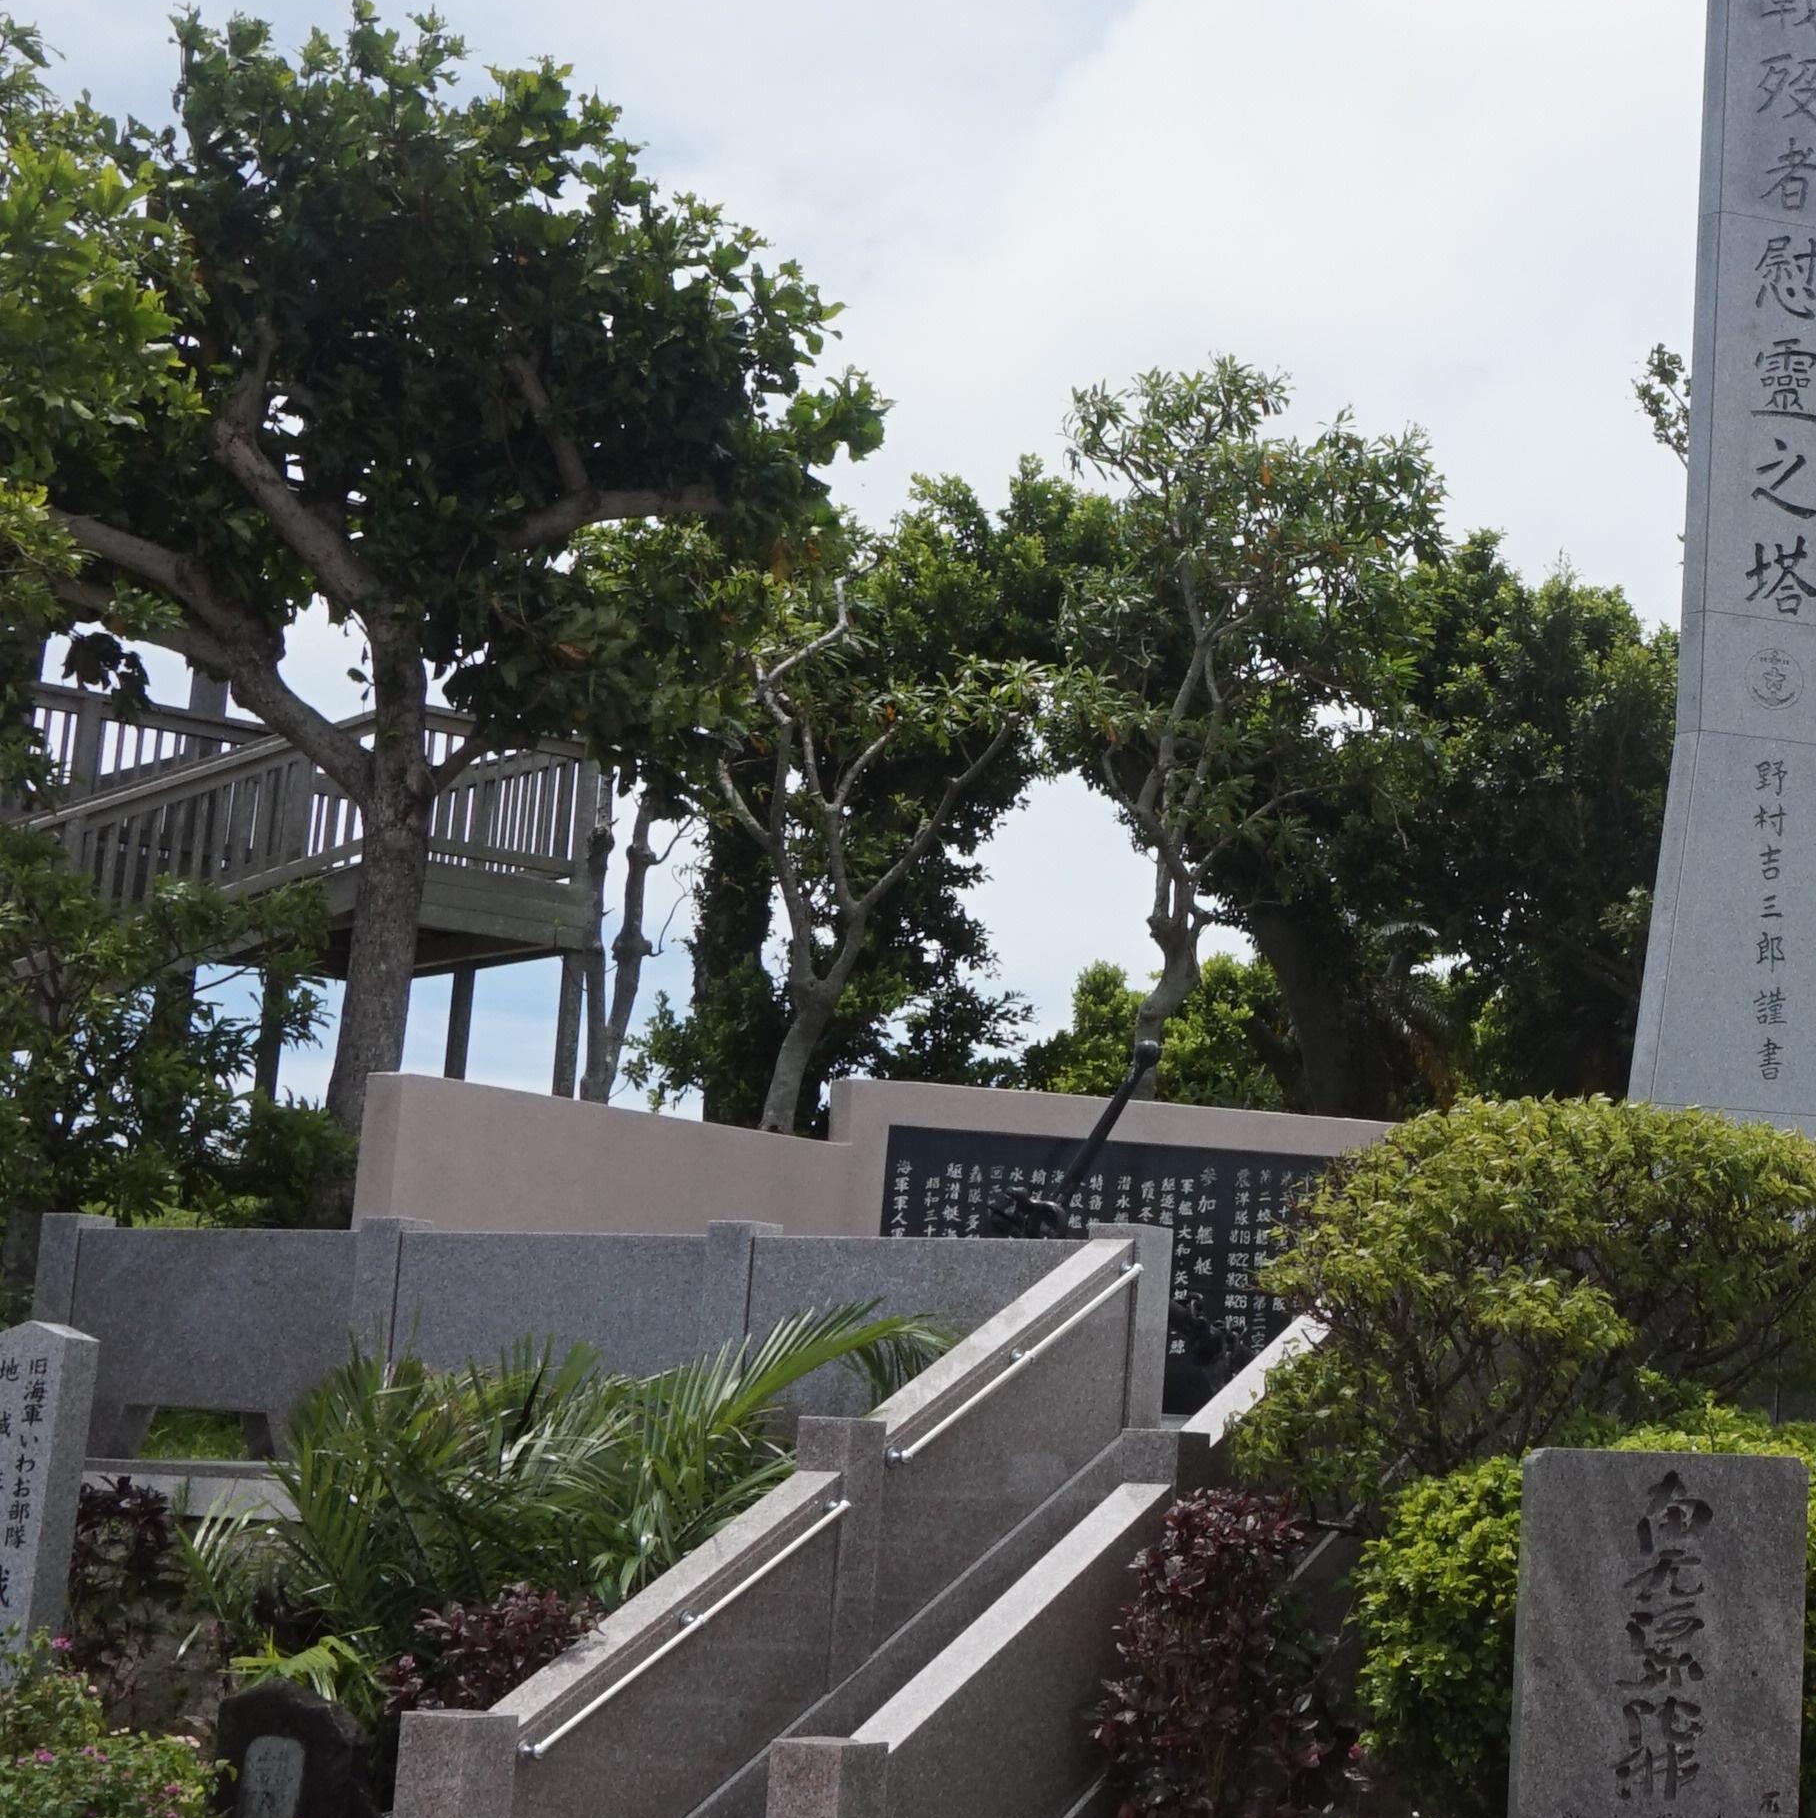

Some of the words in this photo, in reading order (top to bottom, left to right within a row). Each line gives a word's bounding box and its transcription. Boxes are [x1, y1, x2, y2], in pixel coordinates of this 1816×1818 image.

[4, 1358, 48, 1549] 旧海軍いわお部隊
